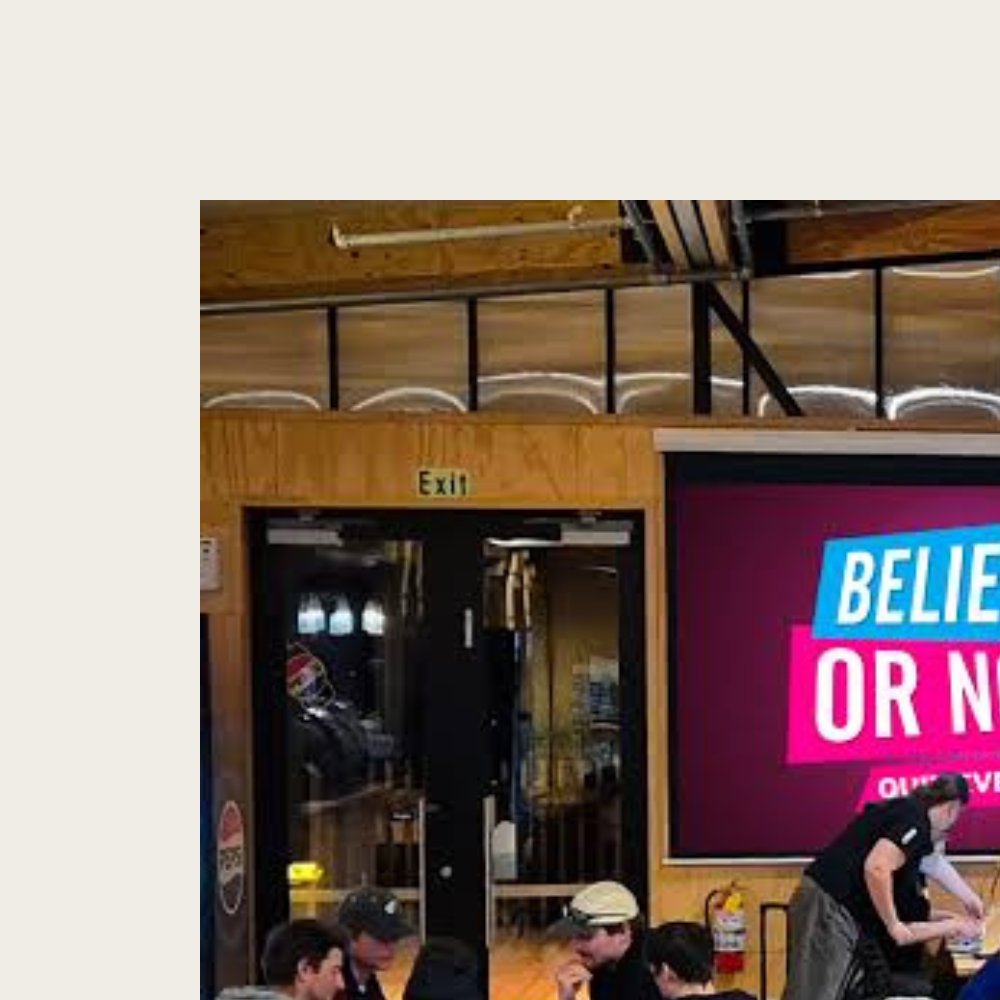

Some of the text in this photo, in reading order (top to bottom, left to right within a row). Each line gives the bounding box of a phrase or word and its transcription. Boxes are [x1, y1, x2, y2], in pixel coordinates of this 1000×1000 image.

[419, 471, 467, 496] Exit
[814, 647, 921, 743] OR
[878, 775, 938, 798] QU
